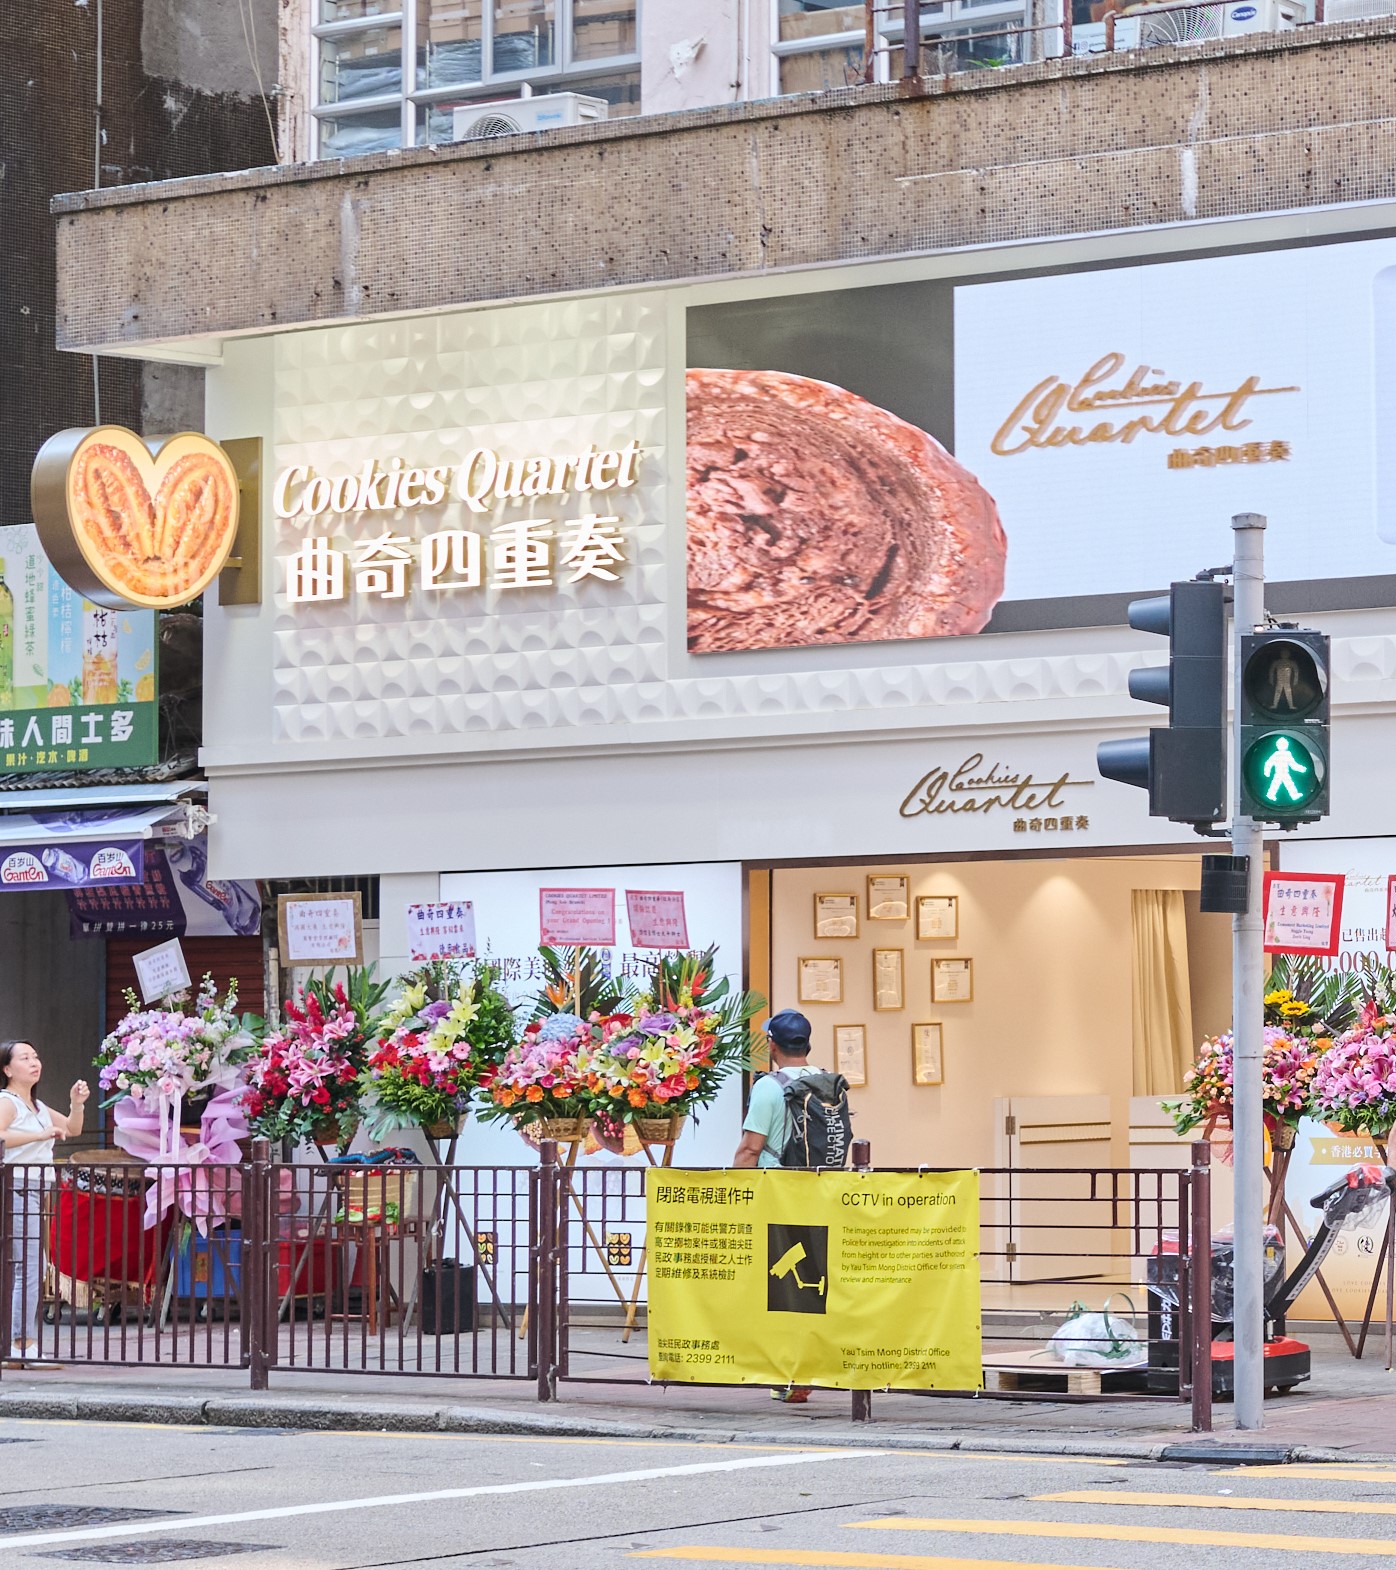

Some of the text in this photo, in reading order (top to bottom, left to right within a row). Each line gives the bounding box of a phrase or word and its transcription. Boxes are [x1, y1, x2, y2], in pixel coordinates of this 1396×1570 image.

[1067, 352, 1182, 411] Cookies
[991, 375, 1301, 455] Quartet
[1168, 440, 1291, 469] 曲奇四重奏
[273, 439, 641, 519] Cookies Quartet
[285, 513, 627, 603] 曲奇四重奏
[949, 753, 1020, 791] Cookies
[900, 766, 1095, 817] Quartet
[1013, 816, 1090, 832] 曲奇四重奏
[8, 857, 34, 868] 百岁山
[98, 852, 124, 863] 百岁山
[4, 866, 45, 881] Ganten
[93, 861, 131, 877] Ganten
[1277, 889, 1317, 899] 曲奇四重奏
[824, 1107, 836, 1165] DIRECTIO
[831, 1107, 846, 1167] ULTIMAT
[1330, 1144, 1390, 1159] 香港必買手
[656, 1186, 754, 1205] 閉路電視運作中
[841, 1192, 956, 1208] CCTV in operation
[655, 1222, 753, 1235] 有關錄像可能供警方調查
[854, 1227, 877, 1236] images
[878, 1227, 909, 1235] captured
[930, 1226, 961, 1236] provided
[655, 1236, 753, 1250] 高空擲物案件或獲油尖旺
[842, 1239, 859, 1247] Police
[868, 1239, 906, 1248] investigation
[944, 1238, 952, 1246] of
[655, 1252, 753, 1266] 民政事務處授權之人士作
[841, 1251, 857, 1259] from
[858, 1251, 879, 1261] height
[889, 1251, 896, 1259] to
[896, 1251, 911, 1259] other
[912, 1251, 933, 1260] parties
[841, 1263, 849, 1272] by
[878, 1264, 895, 1273] Mong
[917, 1262, 938, 1271] Office
[939, 1262, 949, 1270] for
[658, 1338, 720, 1350] 油尖旺民政事務處
[686, 1353, 712, 1364] 2399
[714, 1354, 735, 1364] 2111
[840, 1347, 951, 1358] Yau Tsim Mong District Office
[842, 1361, 937, 1371] Enquiry hotline: 2399 2111
